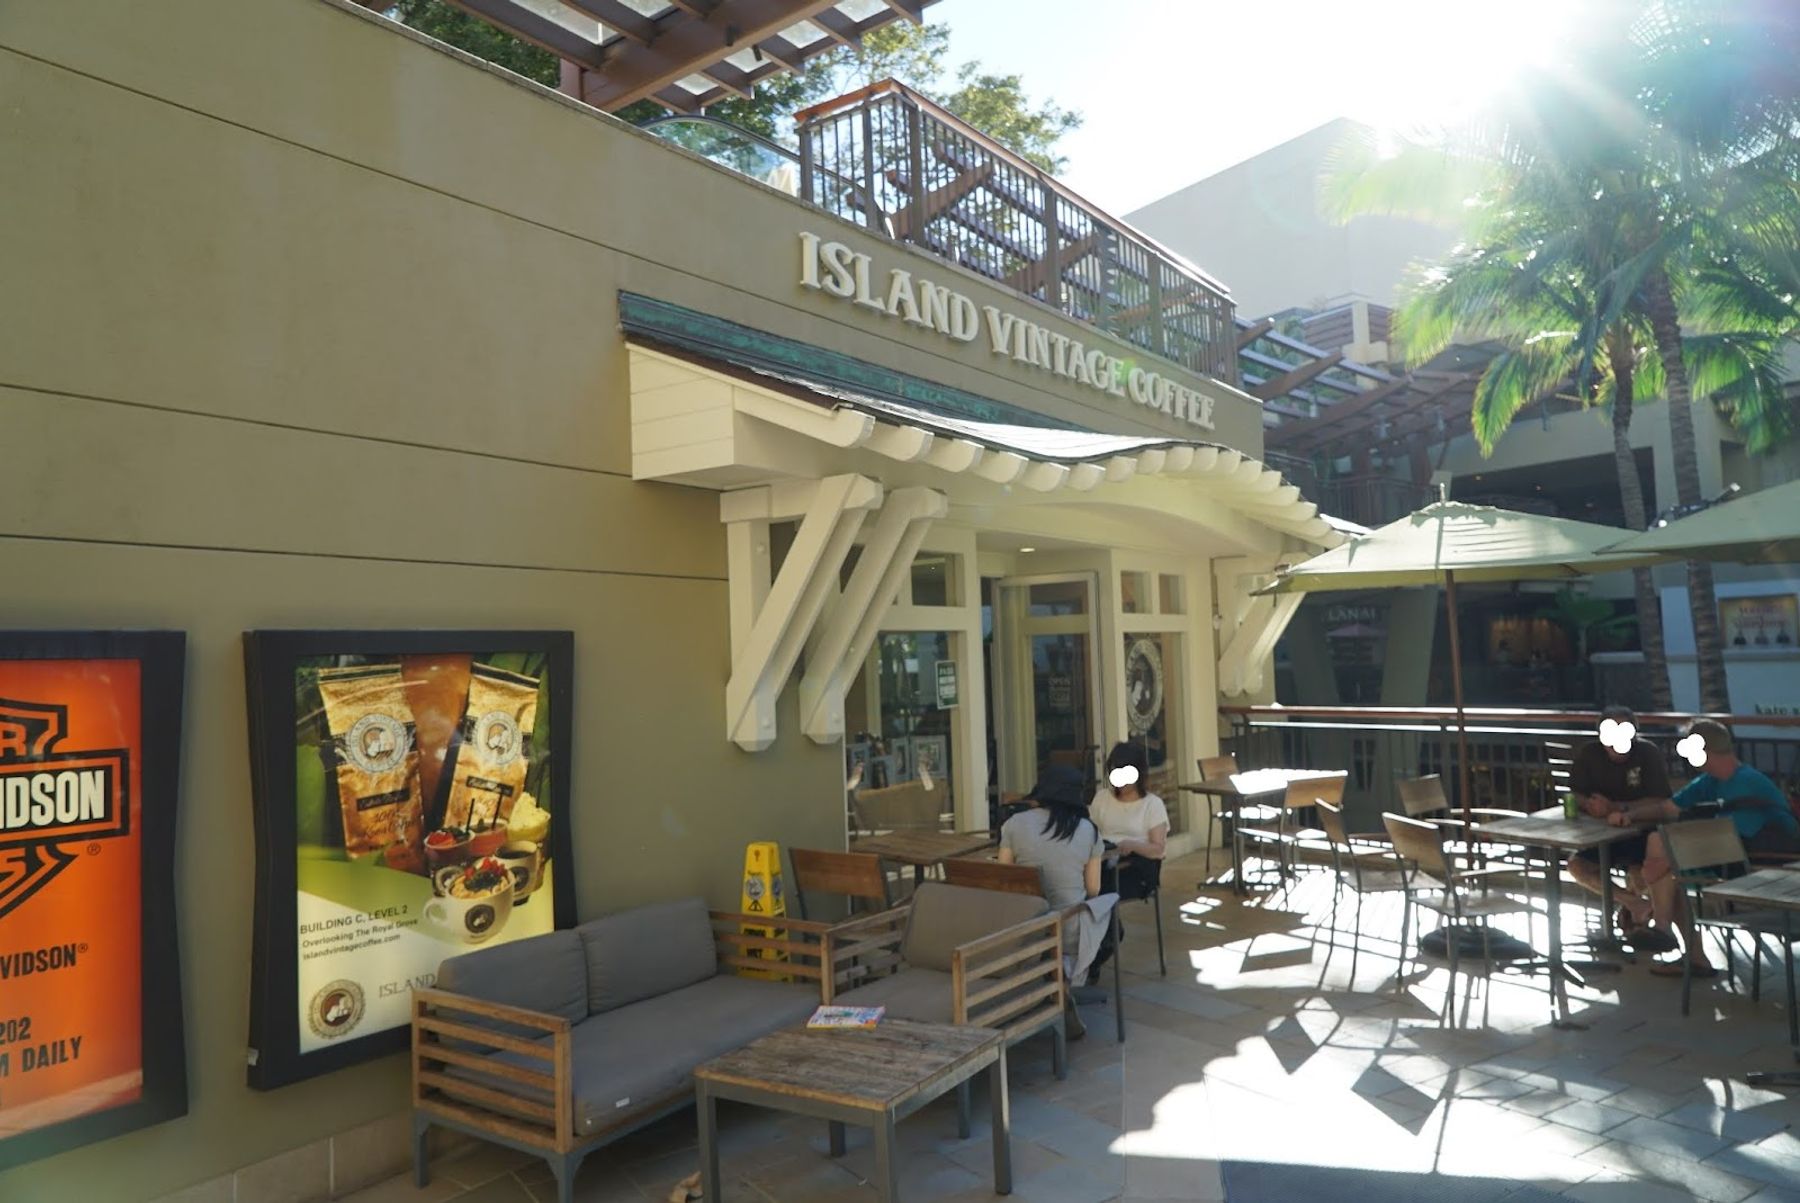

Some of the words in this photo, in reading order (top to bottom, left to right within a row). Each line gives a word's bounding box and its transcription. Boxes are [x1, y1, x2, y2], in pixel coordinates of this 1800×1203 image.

[800, 231, 979, 342] ISLAND
[983, 305, 1126, 397] VINTAGE
[1127, 366, 1215, 430] COFFEE
[300, 916, 352, 934] BUILDING
[368, 907, 399, 921] LEVEL
[401, 904, 408, 914] 2
[302, 932, 354, 948] Overlooking
[356, 928, 370, 937] The
[372, 924, 394, 934] Royal
[22, 1035, 82, 1073] DAILY
